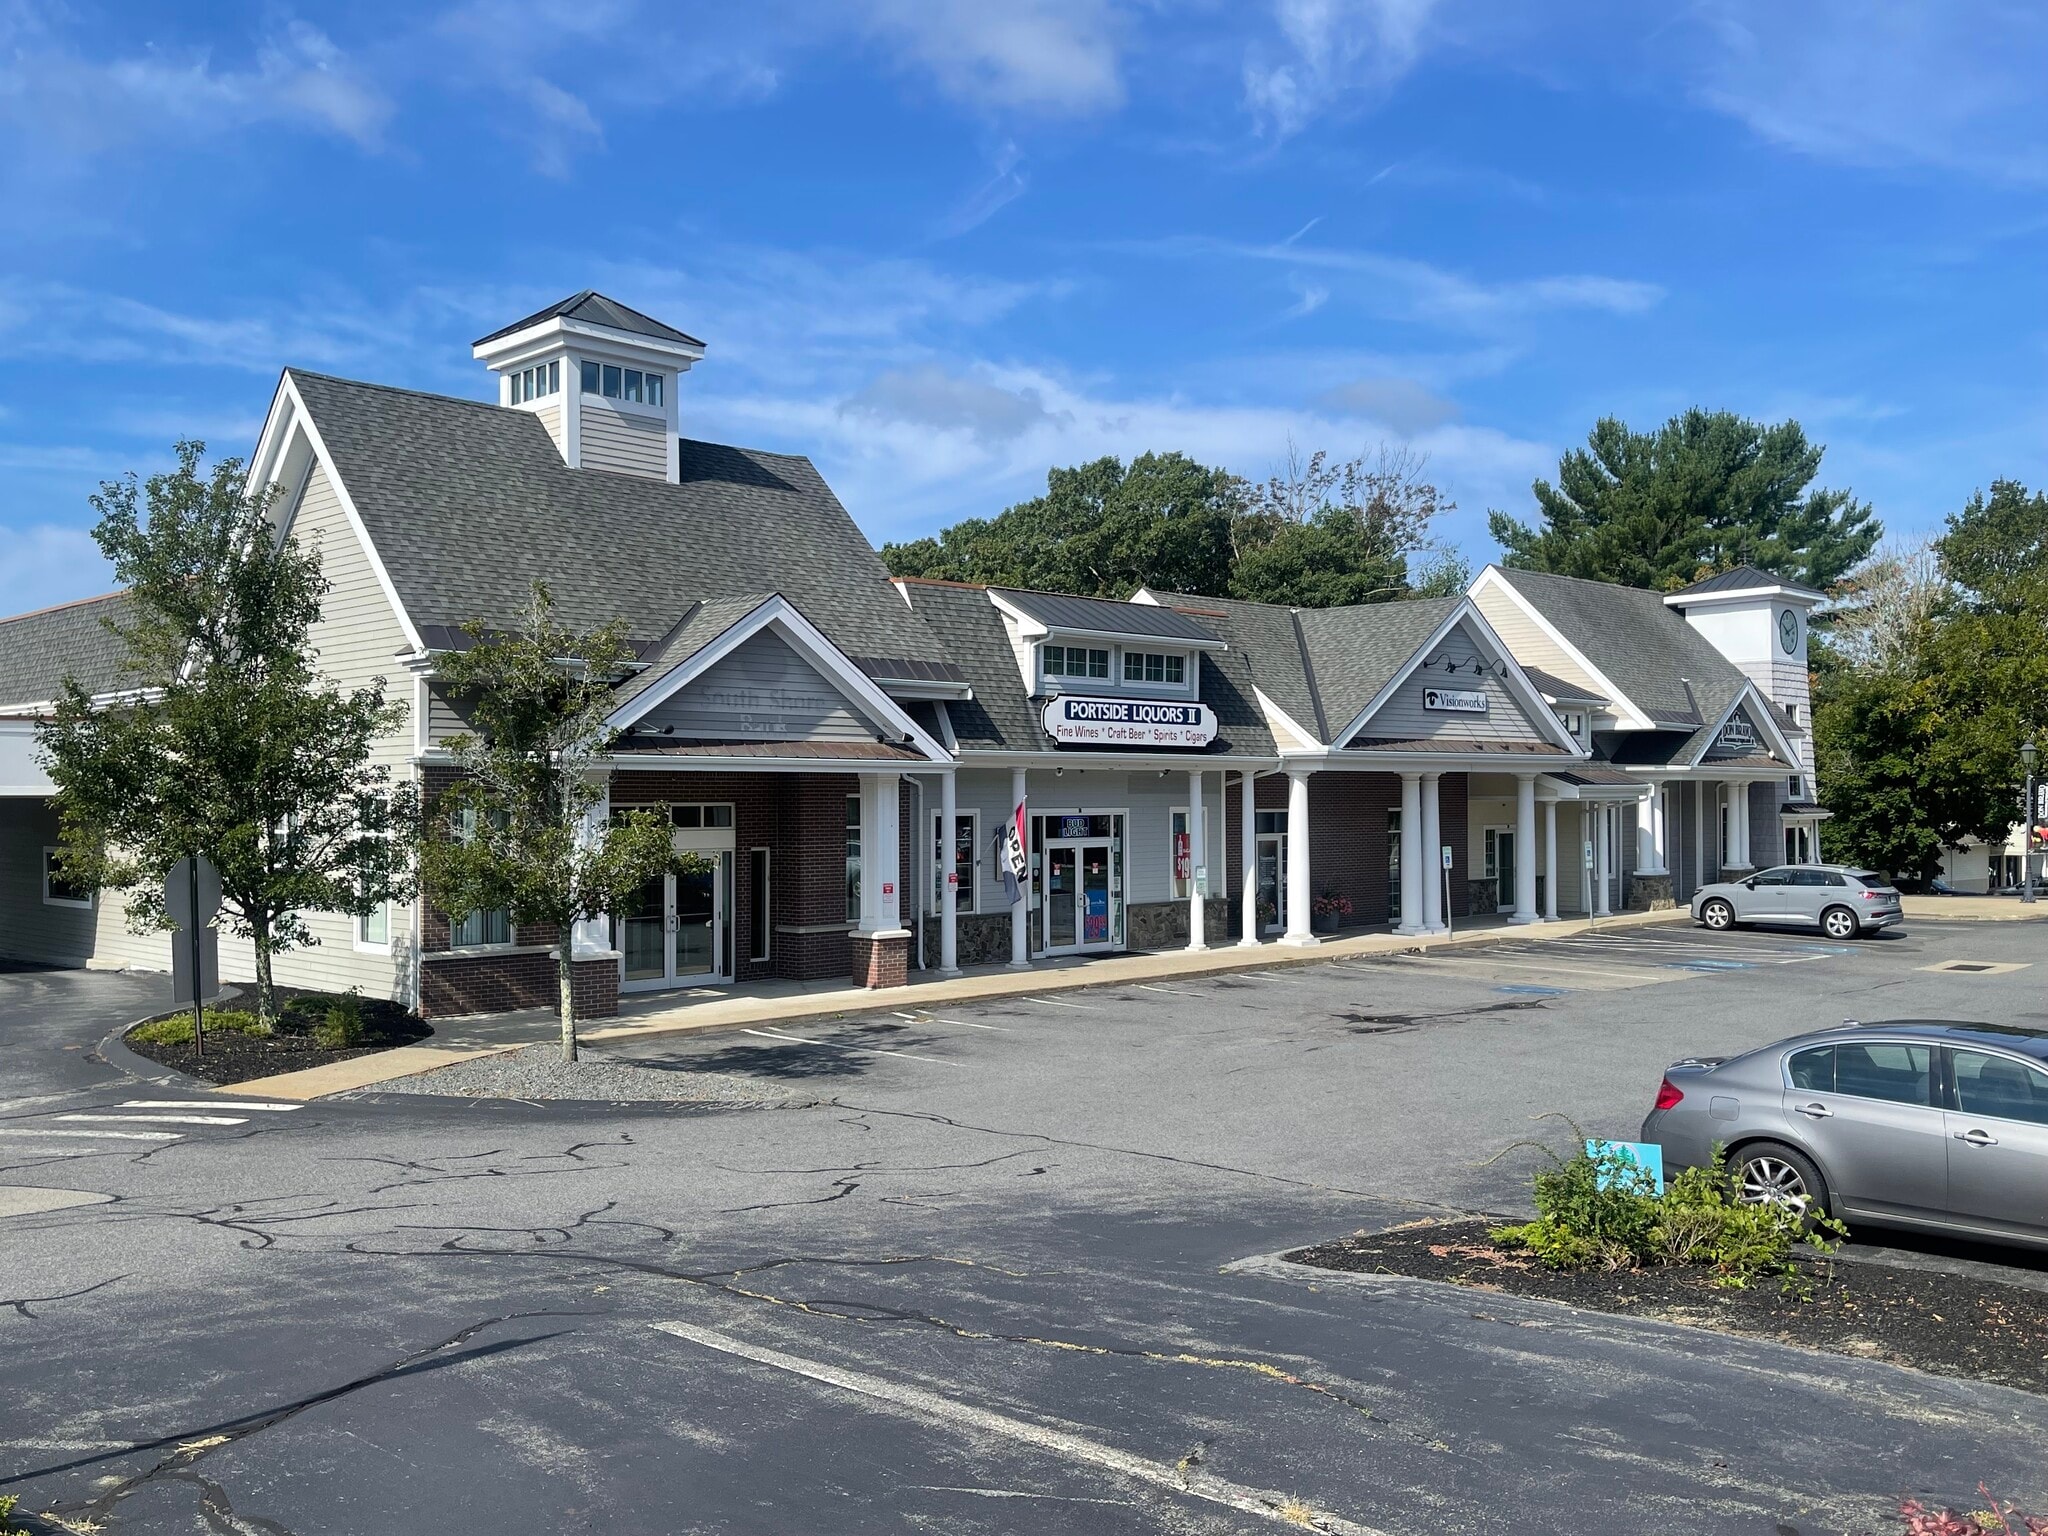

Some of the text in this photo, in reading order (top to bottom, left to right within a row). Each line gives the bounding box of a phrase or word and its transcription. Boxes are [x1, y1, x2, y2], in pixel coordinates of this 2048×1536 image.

[1440, 693, 1485, 709] Visionworks
[1070, 702, 1197, 724] PORTSIDE LIQUORS II
[740, 713, 787, 734] Bank
[1056, 725, 1208, 744] Fine Wines Craft Beer Spirits Cigars
[1063, 827, 1089, 837] LIGHT
[1066, 818, 1085, 828] BUD
[1008, 826, 1028, 884] OPEN
